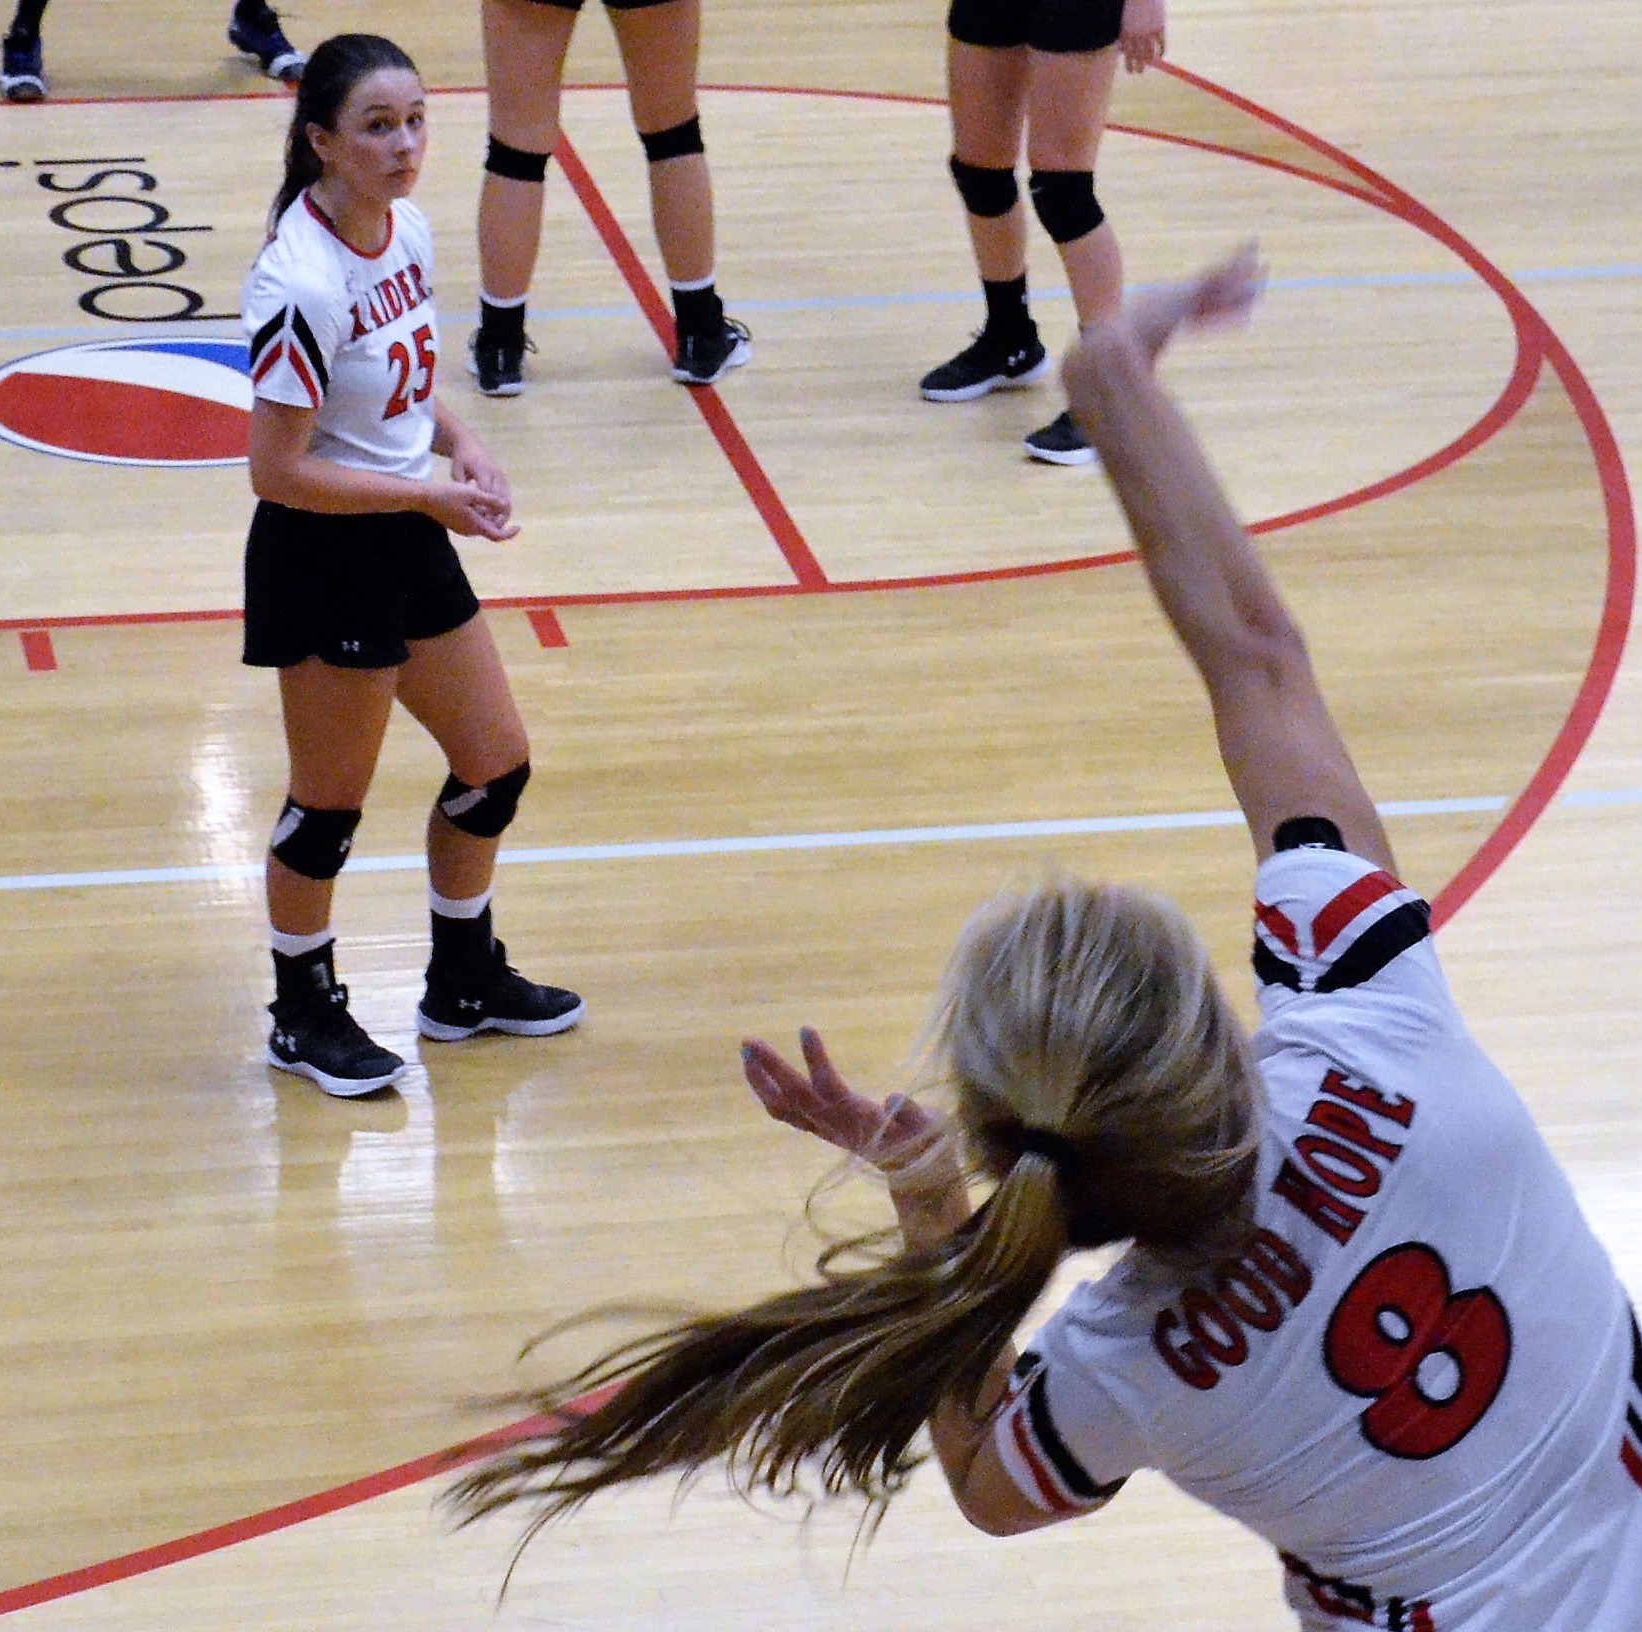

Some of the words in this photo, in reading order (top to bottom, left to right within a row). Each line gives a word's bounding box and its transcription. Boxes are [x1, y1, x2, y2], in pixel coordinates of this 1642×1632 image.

[349, 263, 434, 342] AIDER
[381, 323, 435, 421] 25
[1153, 1227, 1313, 1390] GOOD
[1271, 1068, 1416, 1246] HOPE
[1323, 1241, 1512, 1459] 8
